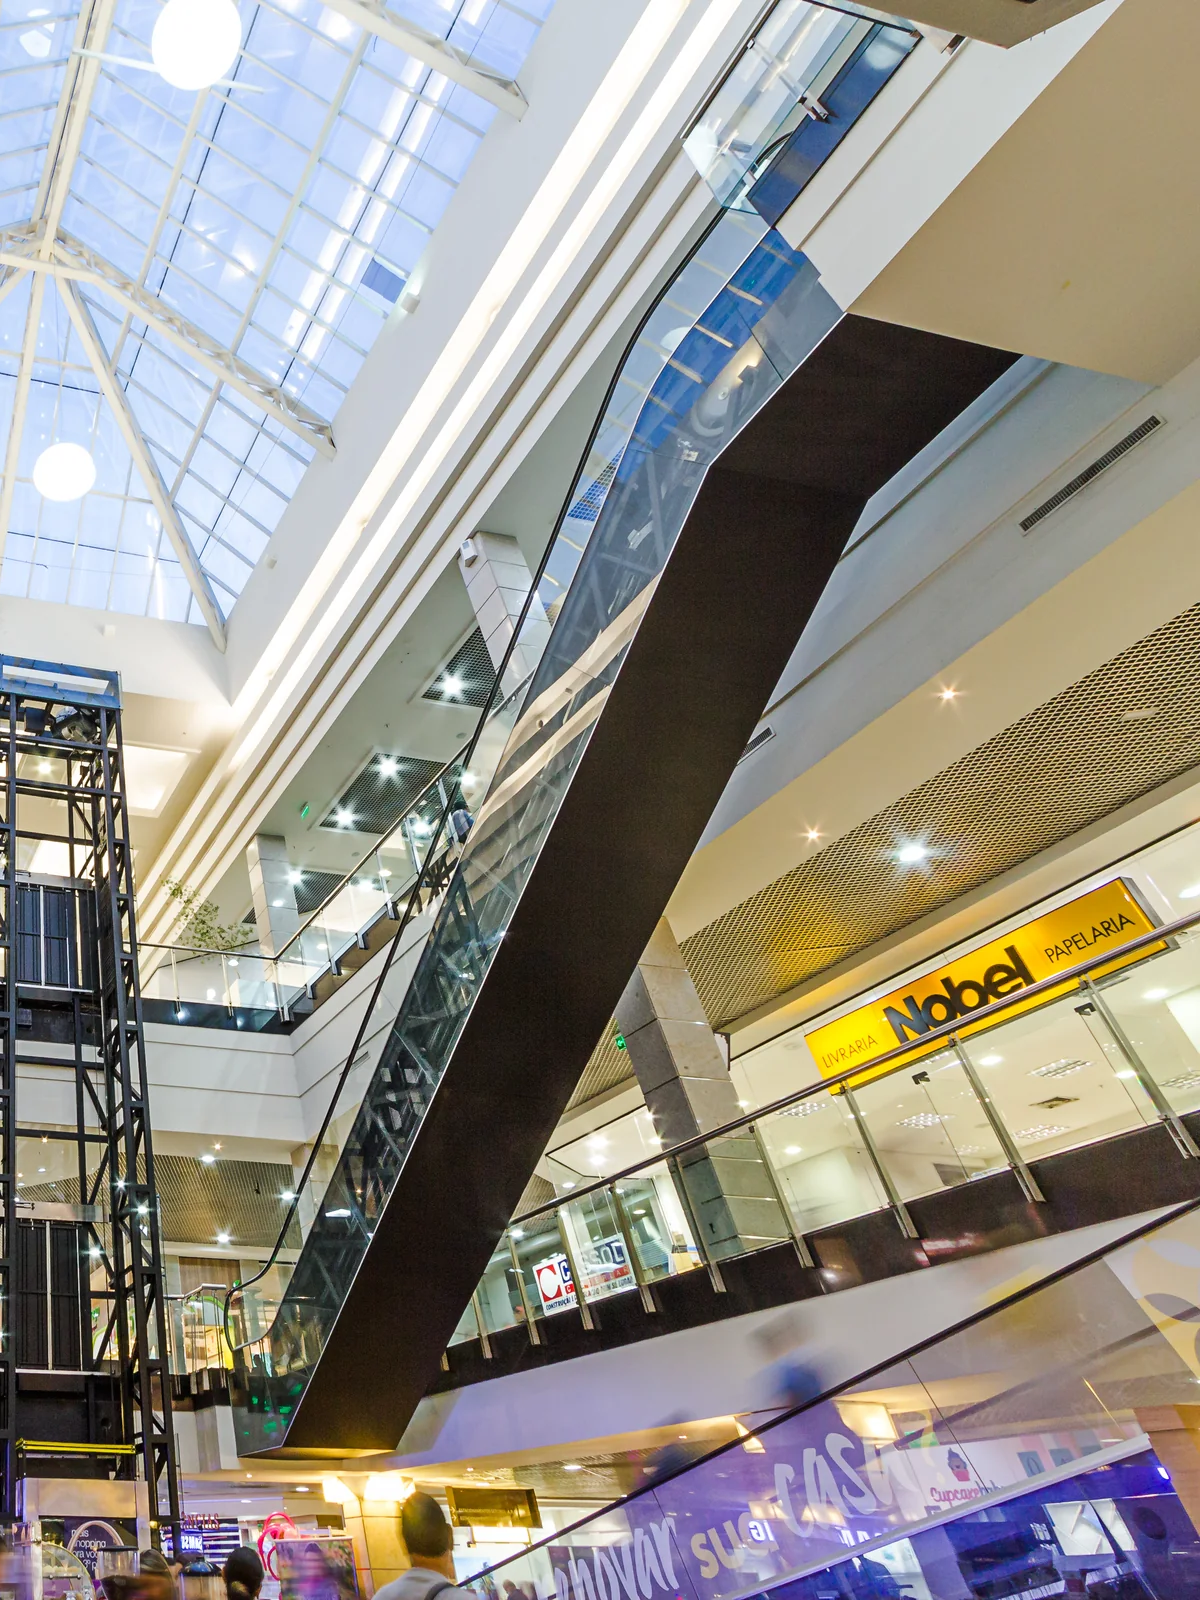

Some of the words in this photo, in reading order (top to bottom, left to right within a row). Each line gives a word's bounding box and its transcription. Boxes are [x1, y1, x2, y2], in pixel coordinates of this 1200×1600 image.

[821, 1034, 879, 1069] LIVRARIA
[883, 945, 1037, 1045] Nobel
[1043, 912, 1136, 964] PAPELARIA
[690, 1512, 779, 1579] sua
